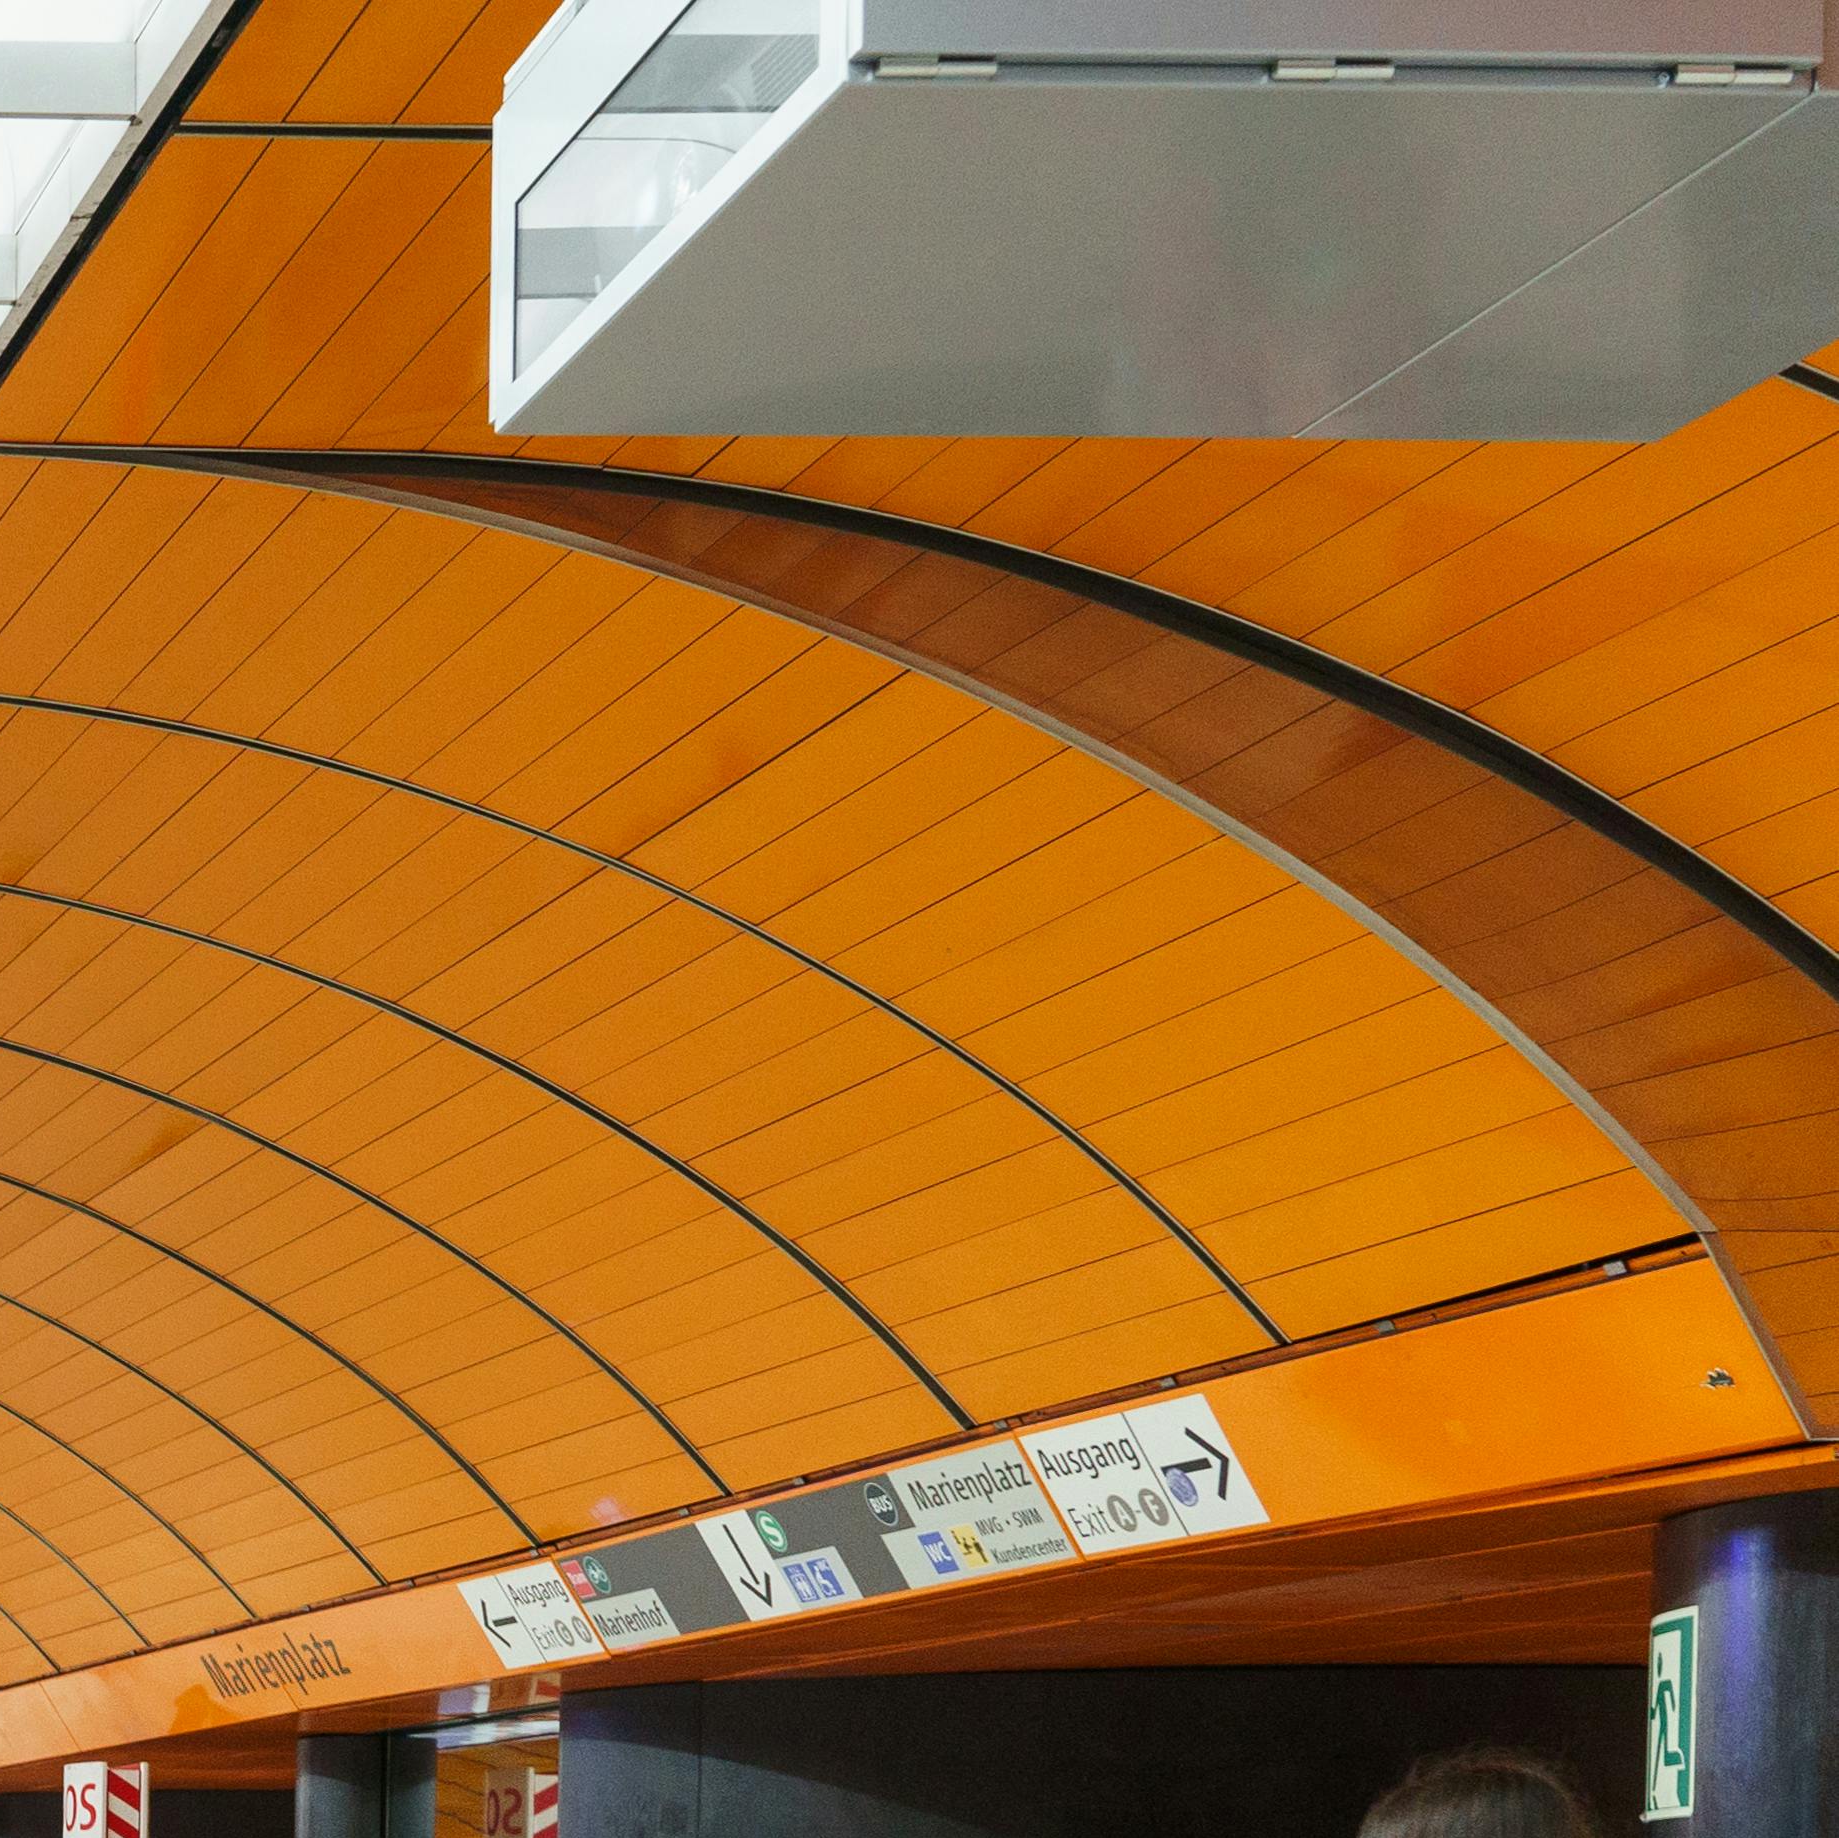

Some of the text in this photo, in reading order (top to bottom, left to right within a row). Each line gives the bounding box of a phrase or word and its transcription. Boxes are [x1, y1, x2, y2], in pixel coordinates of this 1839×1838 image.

[1037, 1437, 1141, 1480] Ausgang
[907, 1459, 1032, 1511] Marienplatz
[869, 1497, 893, 1514] BUS
[1067, 1503, 1115, 1538] Exit
[759, 1515, 784, 1547] S
[975, 1508, 1044, 1537] MVG SWM
[924, 1541, 952, 1563] WC
[991, 1537, 1068, 1565] Kundencenter
[506, 1577, 570, 1607] Ausgang
[593, 1600, 667, 1638] Marienhof
[532, 1623, 562, 1649] Exit
[200, 1632, 352, 1699] Marienplatz
